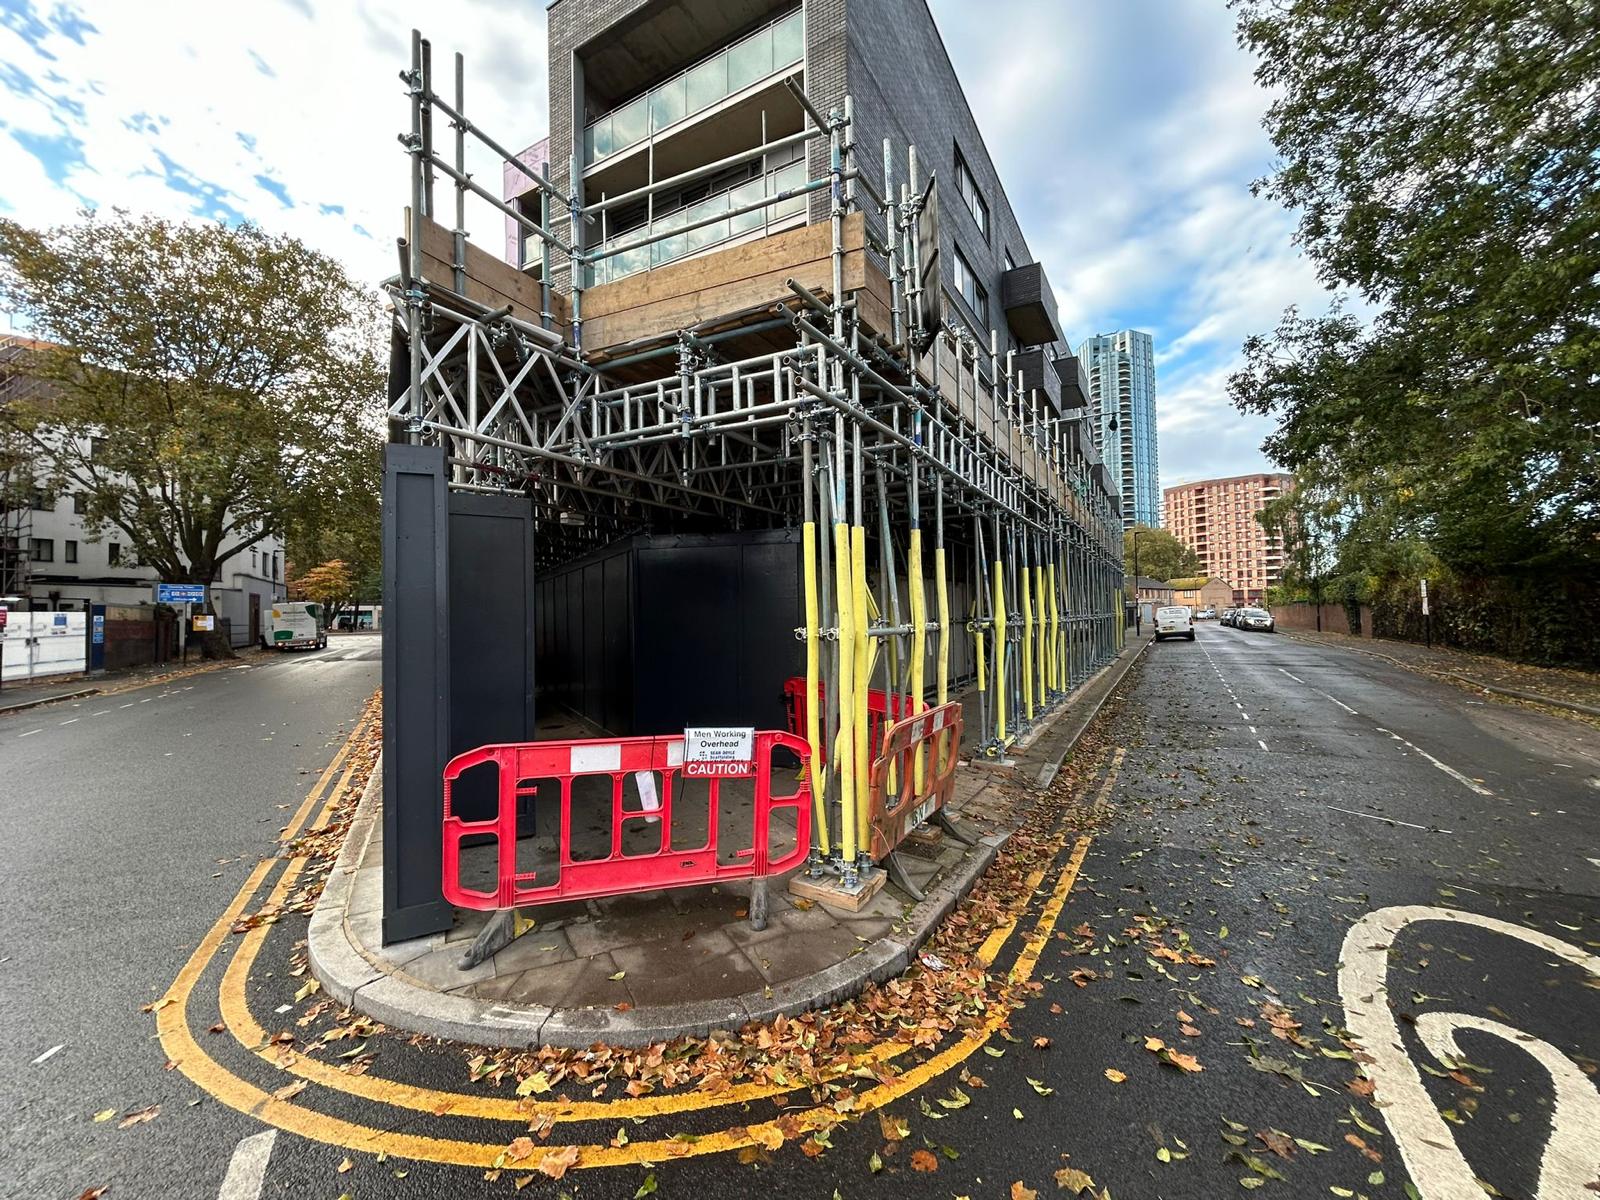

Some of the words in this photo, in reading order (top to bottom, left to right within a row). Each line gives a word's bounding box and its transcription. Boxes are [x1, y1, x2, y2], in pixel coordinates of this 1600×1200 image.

[694, 730, 711, 738] Men
[713, 730, 747, 739] Working
[700, 740, 739, 748] Overhead
[687, 763, 748, 775] CAUTION
